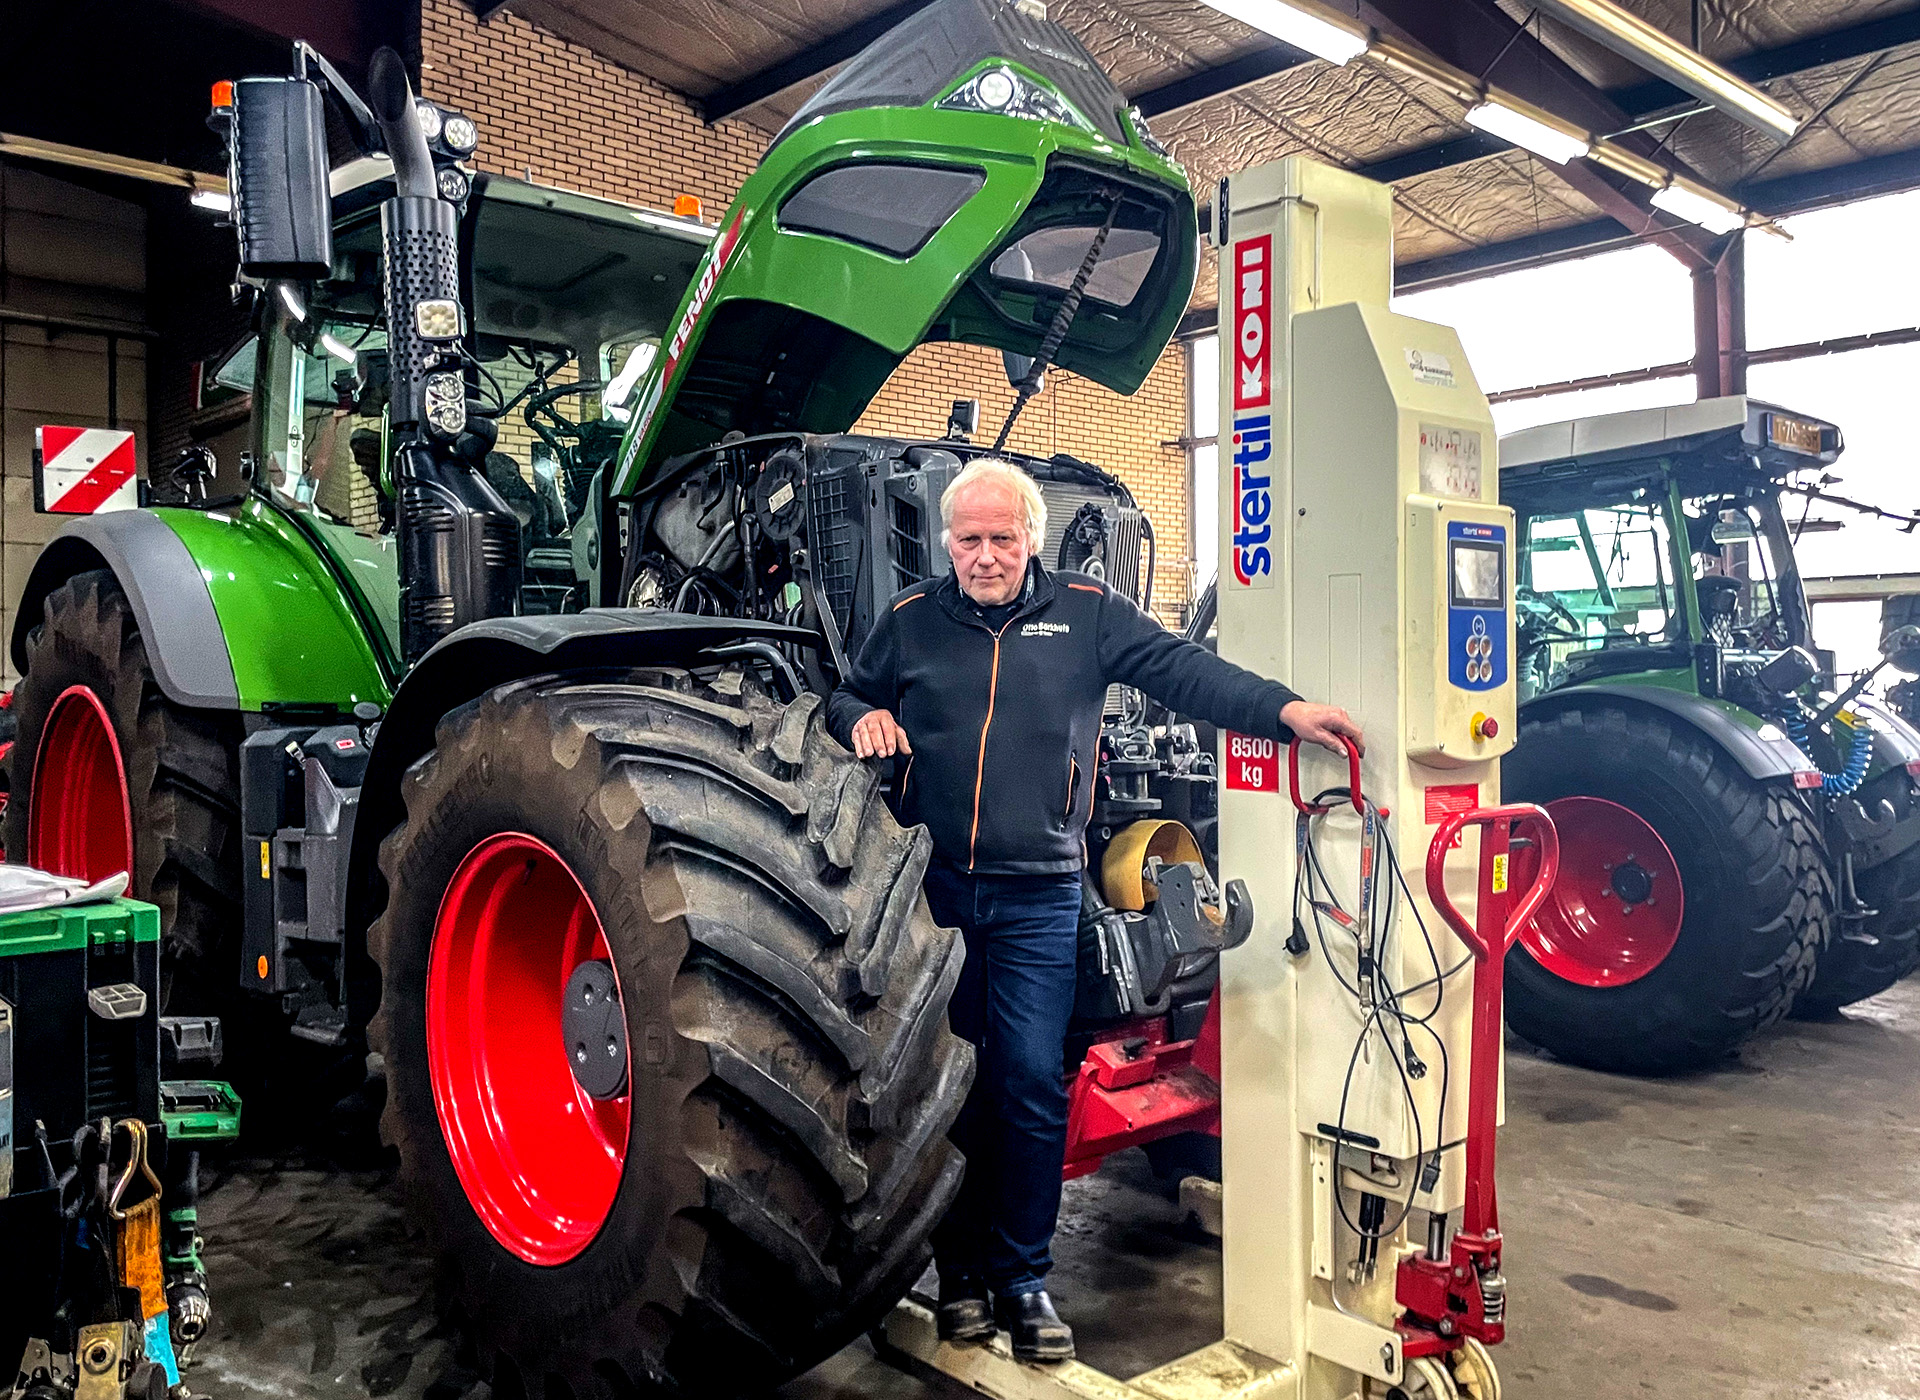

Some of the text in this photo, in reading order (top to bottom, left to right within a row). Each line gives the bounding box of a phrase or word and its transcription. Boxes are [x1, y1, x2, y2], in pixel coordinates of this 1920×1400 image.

[668, 254, 721, 361] FENDT
[1233, 247, 1271, 578] stertil KONI
[1231, 737, 1273, 788] 8500 kg
